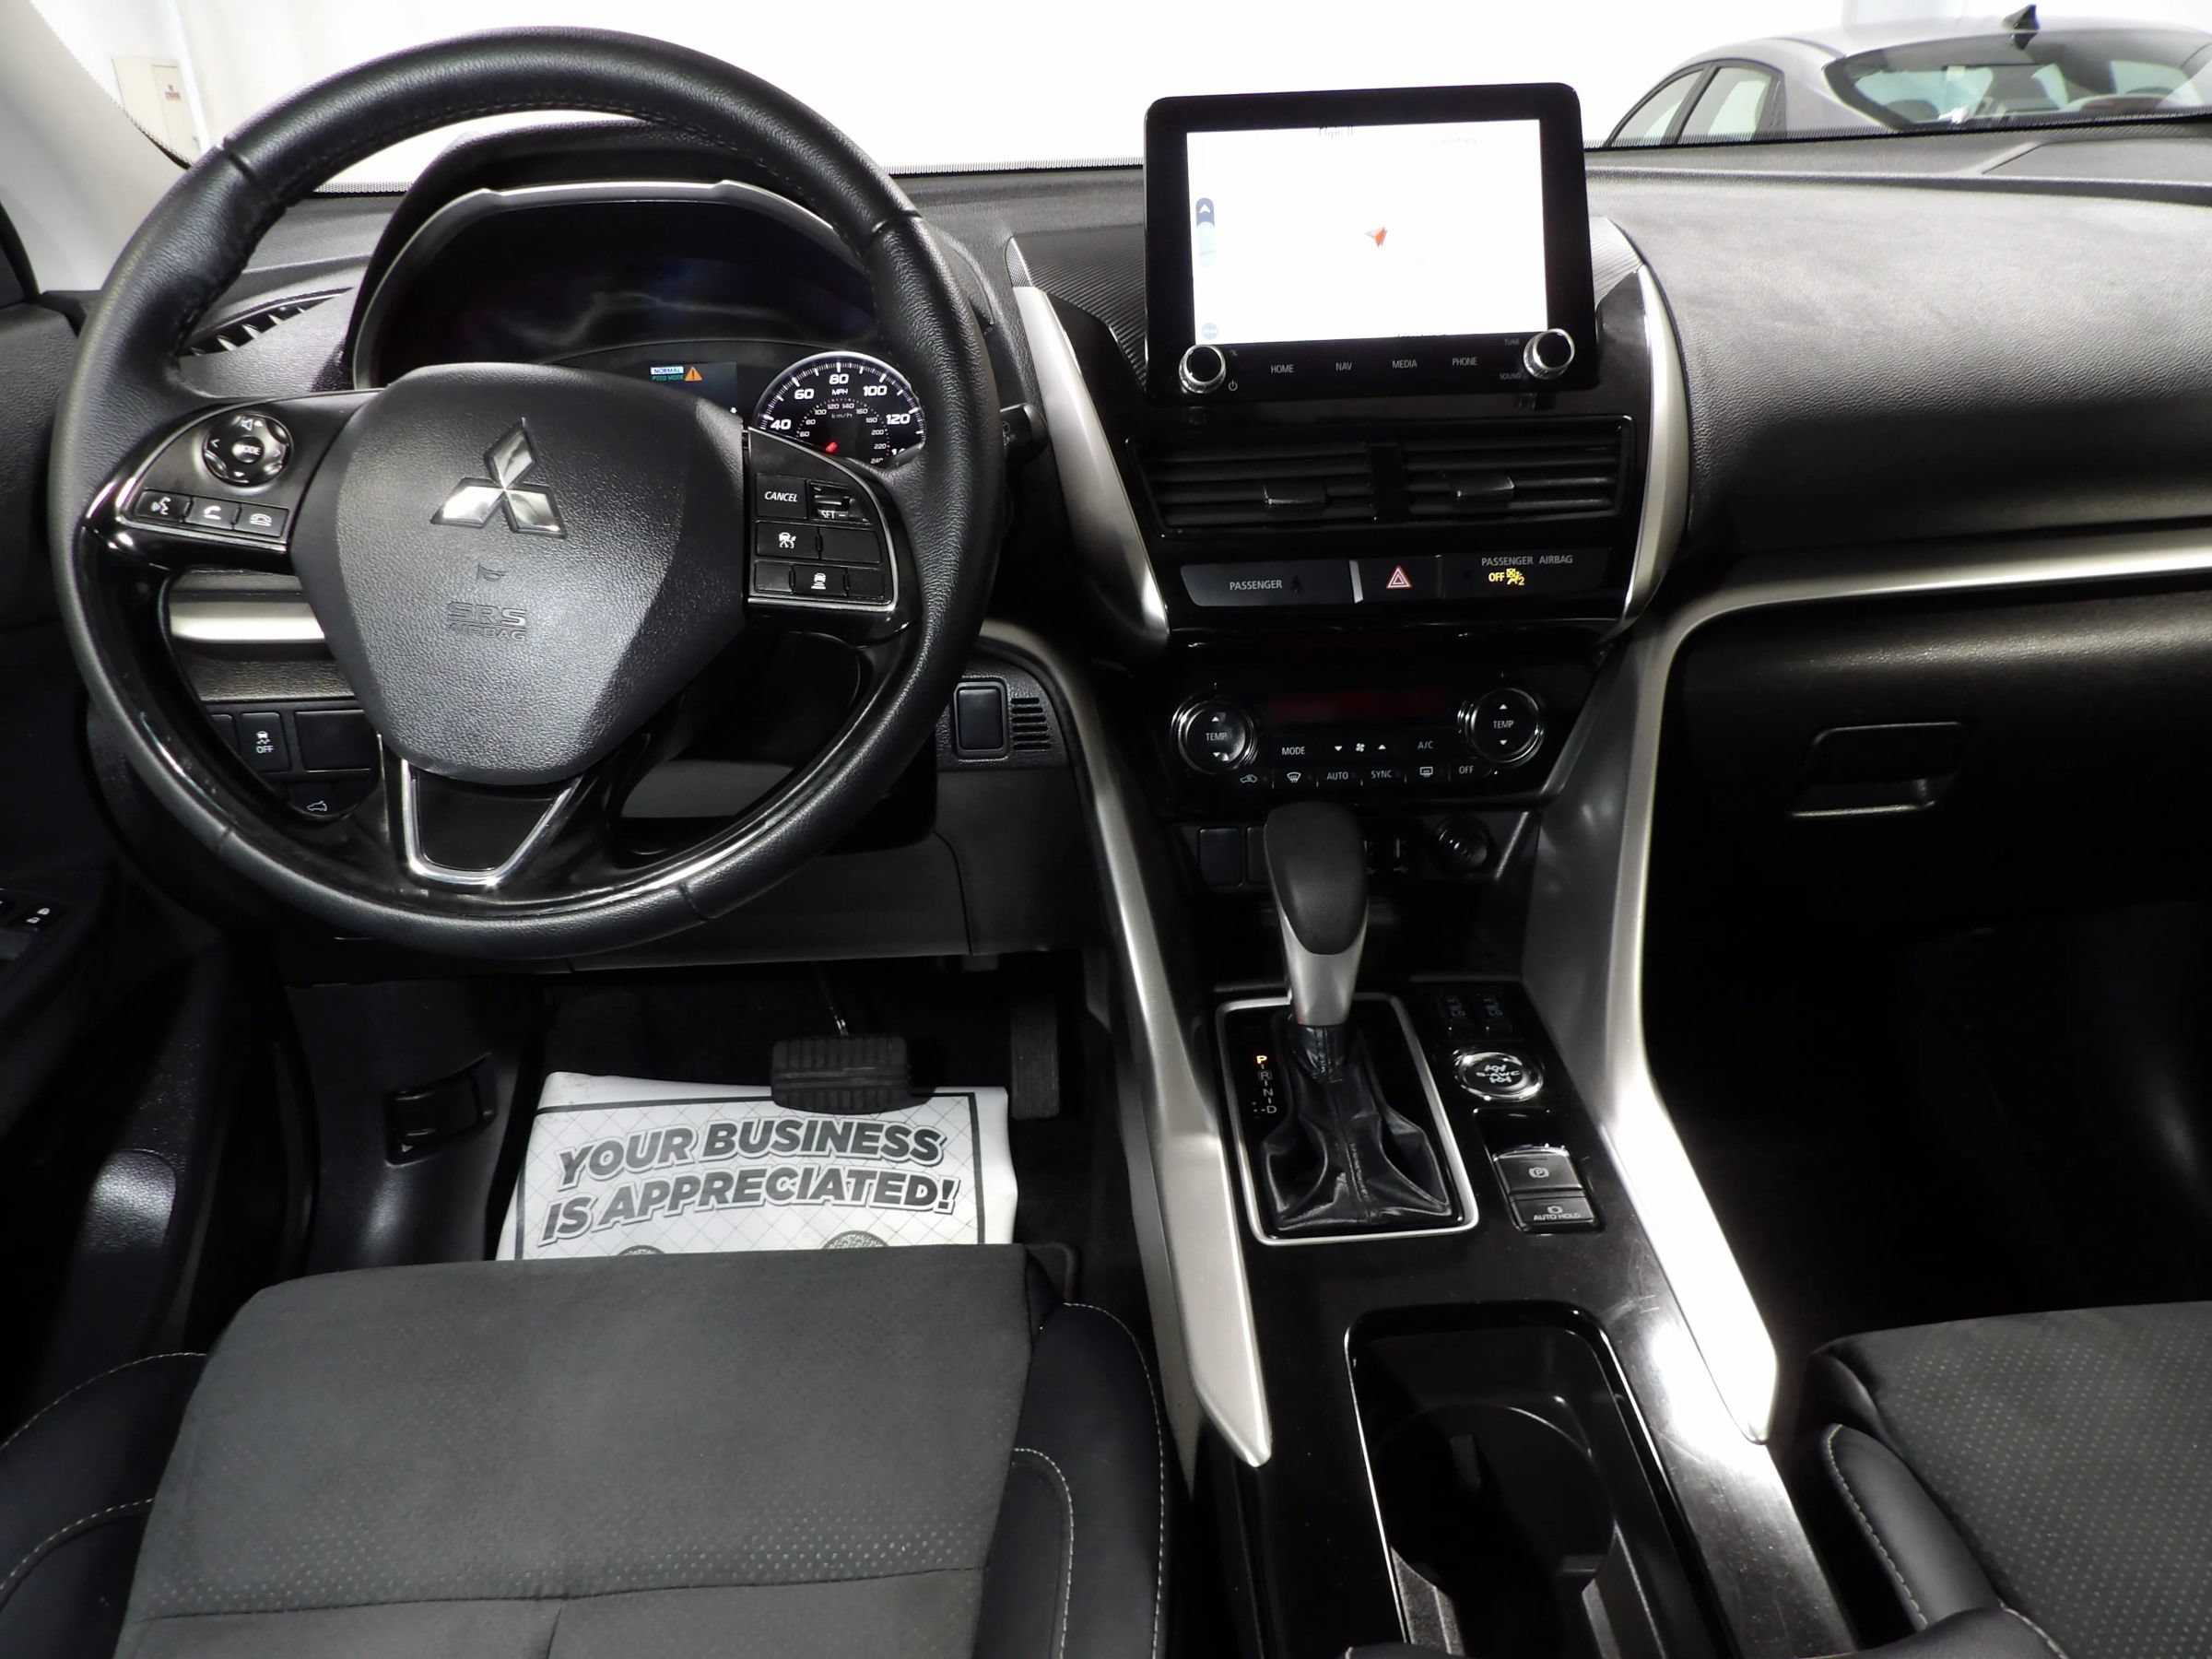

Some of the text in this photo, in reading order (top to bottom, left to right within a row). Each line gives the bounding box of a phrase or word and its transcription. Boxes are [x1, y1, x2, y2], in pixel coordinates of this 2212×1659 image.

[1335, 361, 1353, 371] NAV
[1392, 359, 1418, 369] MEDIA
[1452, 357, 1477, 367] PHONE
[1270, 363, 1294, 374] HOME
[829, 373, 850, 384] 80
[794, 388, 815, 400] 60
[863, 385, 888, 396] 100
[771, 419, 792, 430] 40
[886, 414, 911, 425] 120
[764, 491, 798, 502] CANCEL
[821, 510, 835, 519] SET
[1481, 555, 1573, 566] PASSENGER AIRBAG
[1488, 572, 1505, 582] OFF
[1230, 580, 1283, 591] PASSENGER
[448, 602, 527, 628] SRS
[1493, 719, 1514, 729] TEMP
[1206, 732, 1228, 742] TEMP
[255, 745, 275, 754] OFF
[1418, 740, 1434, 750] A/C
[1281, 746, 1306, 756] MODE
[1371, 770, 1393, 780] SYNC
[1458, 765, 1475, 775] OFF
[1326, 771, 1349, 781] AUTO
[1256, 1054, 1268, 1065] P
[1262, 1088, 1274, 1097] N
[1265, 1105, 1277, 1114] D
[554, 1116, 947, 1193] YOUR BUSINESS
[537, 1163, 960, 1246] IS APPRECIATED!
[1533, 1211, 1582, 1221] AUTO HOLD
